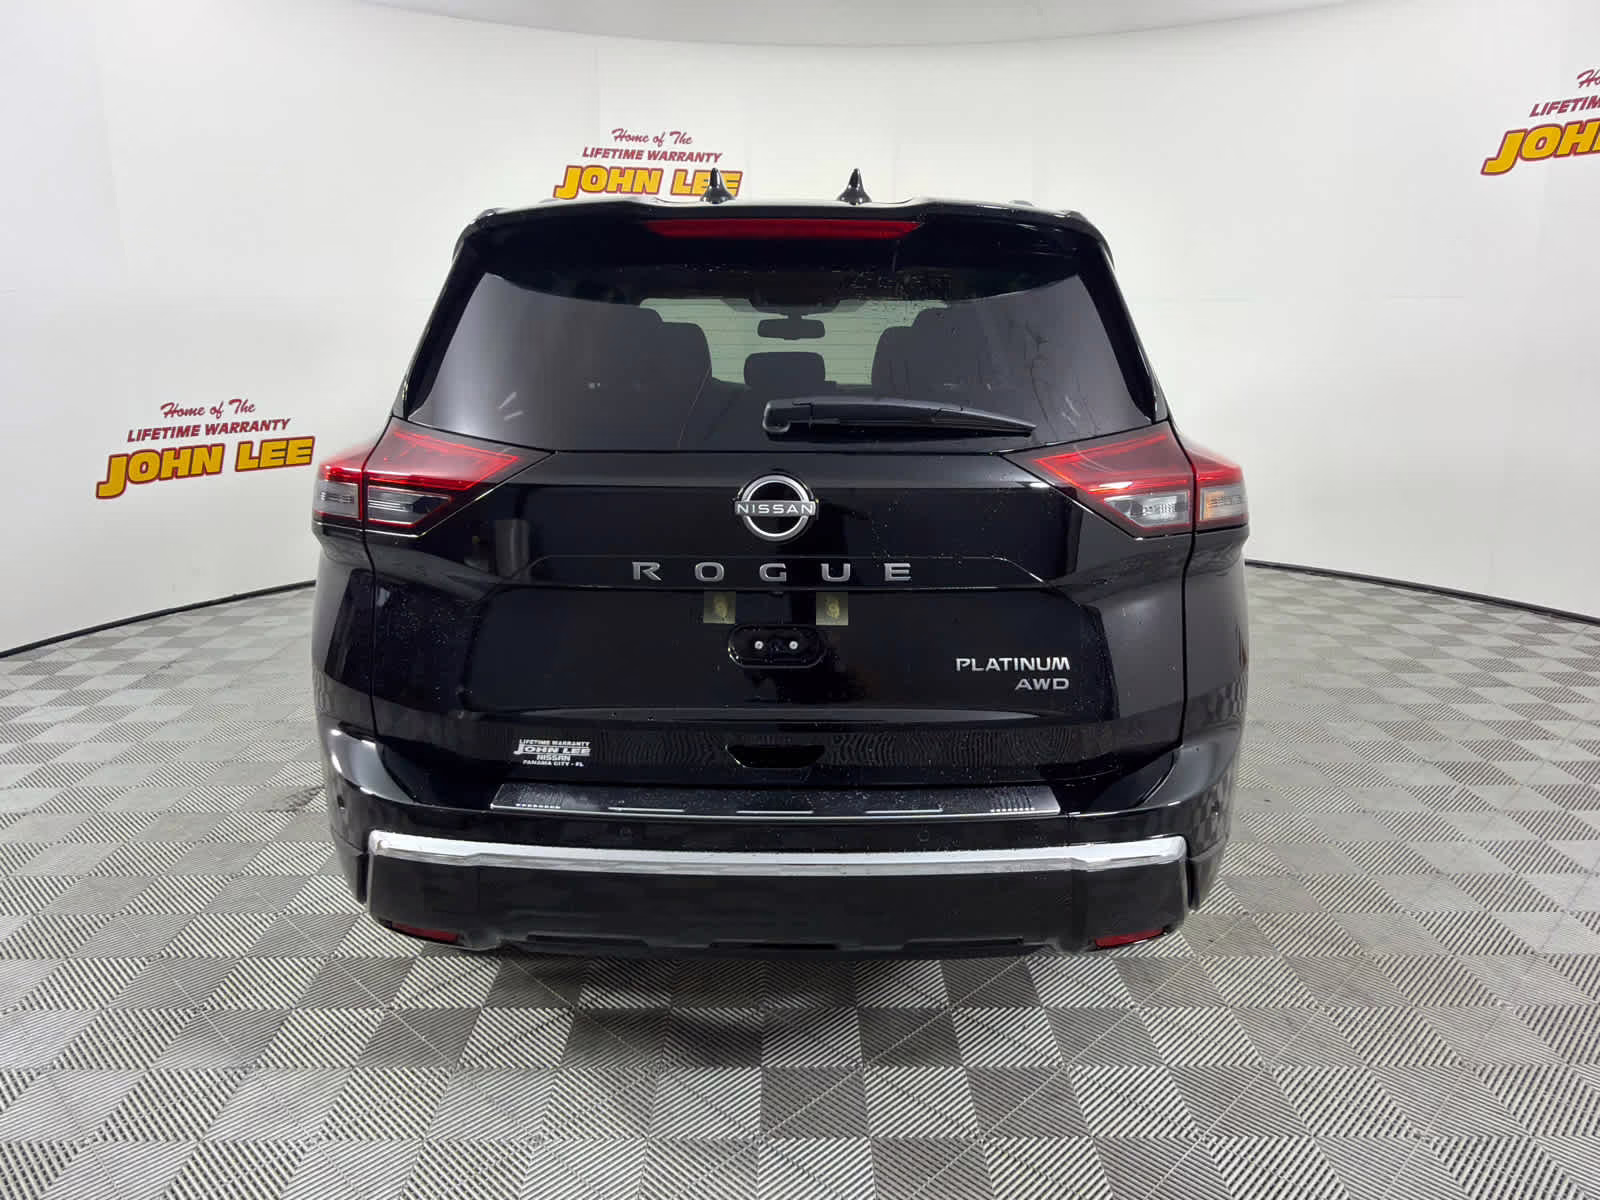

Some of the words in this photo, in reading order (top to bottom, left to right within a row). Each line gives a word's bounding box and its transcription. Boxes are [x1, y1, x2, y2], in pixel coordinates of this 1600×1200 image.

[611, 128, 649, 143] Home
[652, 133, 665, 148] of
[669, 131, 693, 145] The
[582, 147, 644, 160] LIFETIME
[648, 151, 722, 163] WARRANTY
[553, 165, 664, 200] JOHN
[160, 402, 205, 418] Home
[209, 402, 224, 419] of
[228, 399, 255, 415] The
[127, 424, 201, 442] LIFETIME
[205, 418, 291, 436] WARRANTY
[96, 443, 226, 499] JOHN
[235, 436, 315, 472] LEE
[737, 503, 814, 514] NISSAN
[632, 561, 911, 582] ROGUE
[956, 657, 1071, 671] PLATINUM
[1015, 678, 1070, 690] AWD
[513, 743, 559, 755] JOHN
[562, 747, 591, 756] LEE
